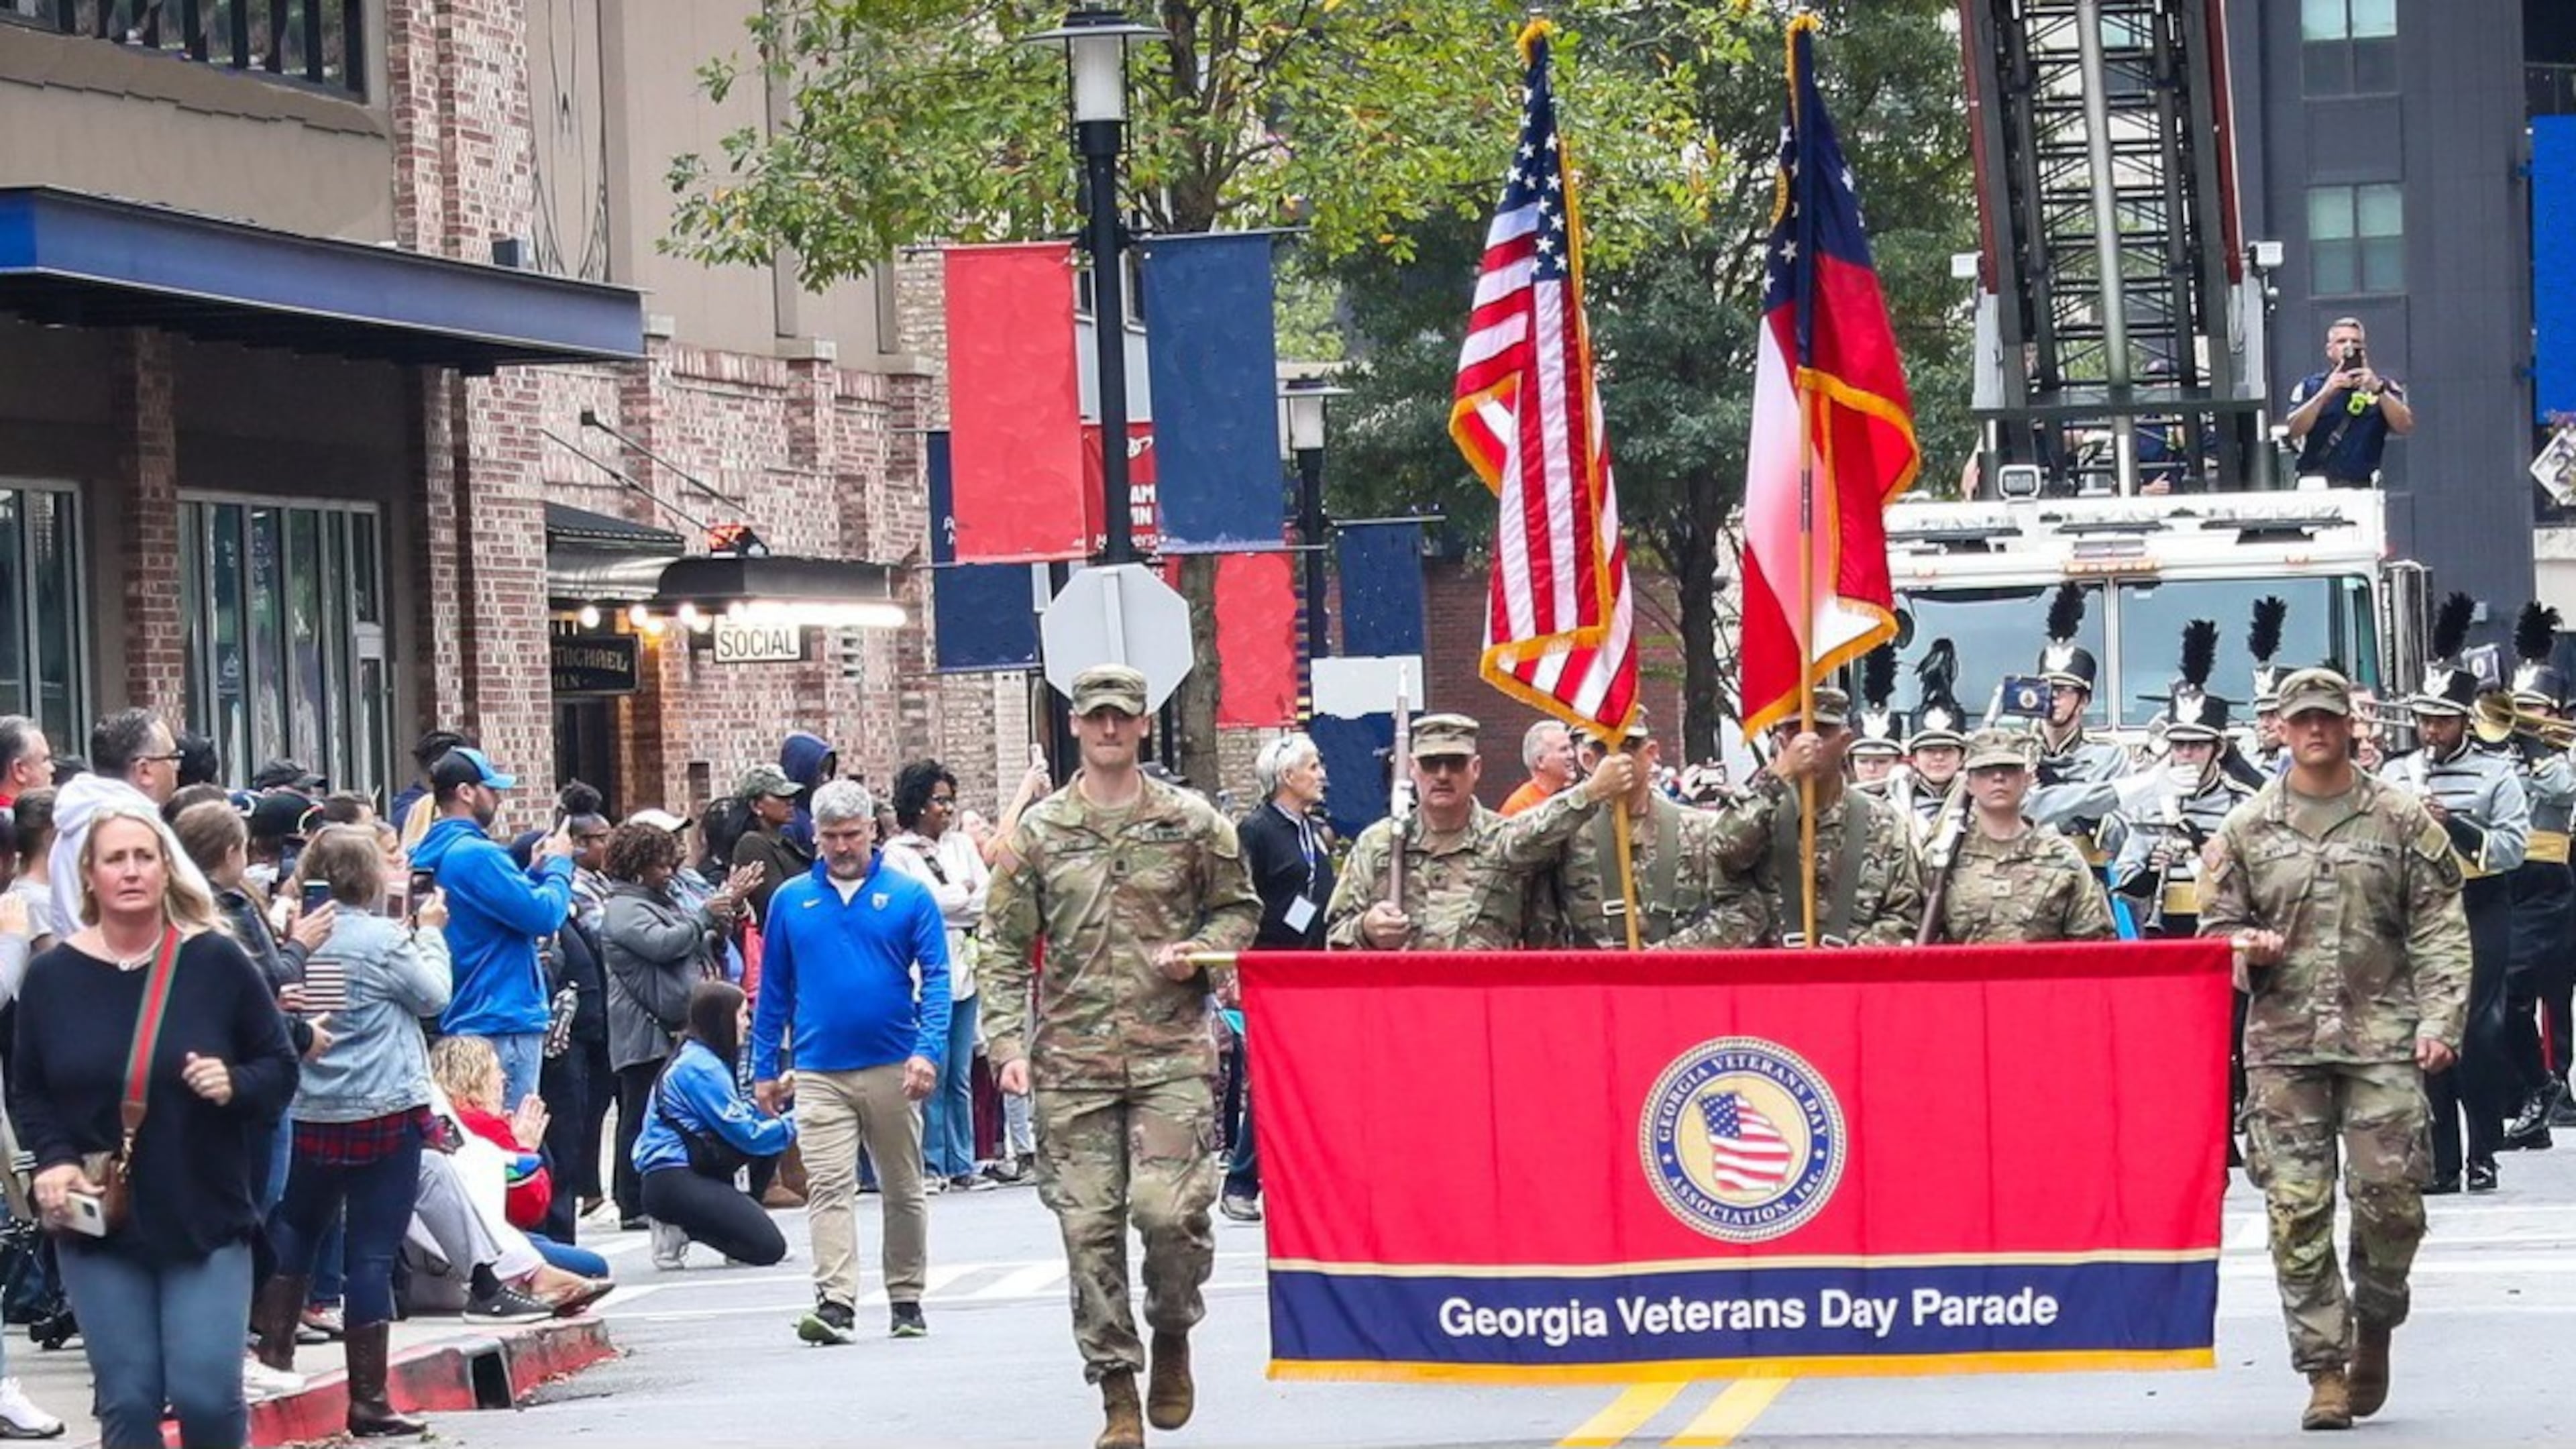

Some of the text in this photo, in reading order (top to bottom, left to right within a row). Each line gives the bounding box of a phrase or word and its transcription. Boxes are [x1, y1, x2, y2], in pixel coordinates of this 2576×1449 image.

[718, 629, 797, 657] SOCIAL
[1658, 1055, 1826, 1141] GEORGIA VETERANS DAY
[1439, 1287, 2059, 1346] Georgia Veterans Day Parade
